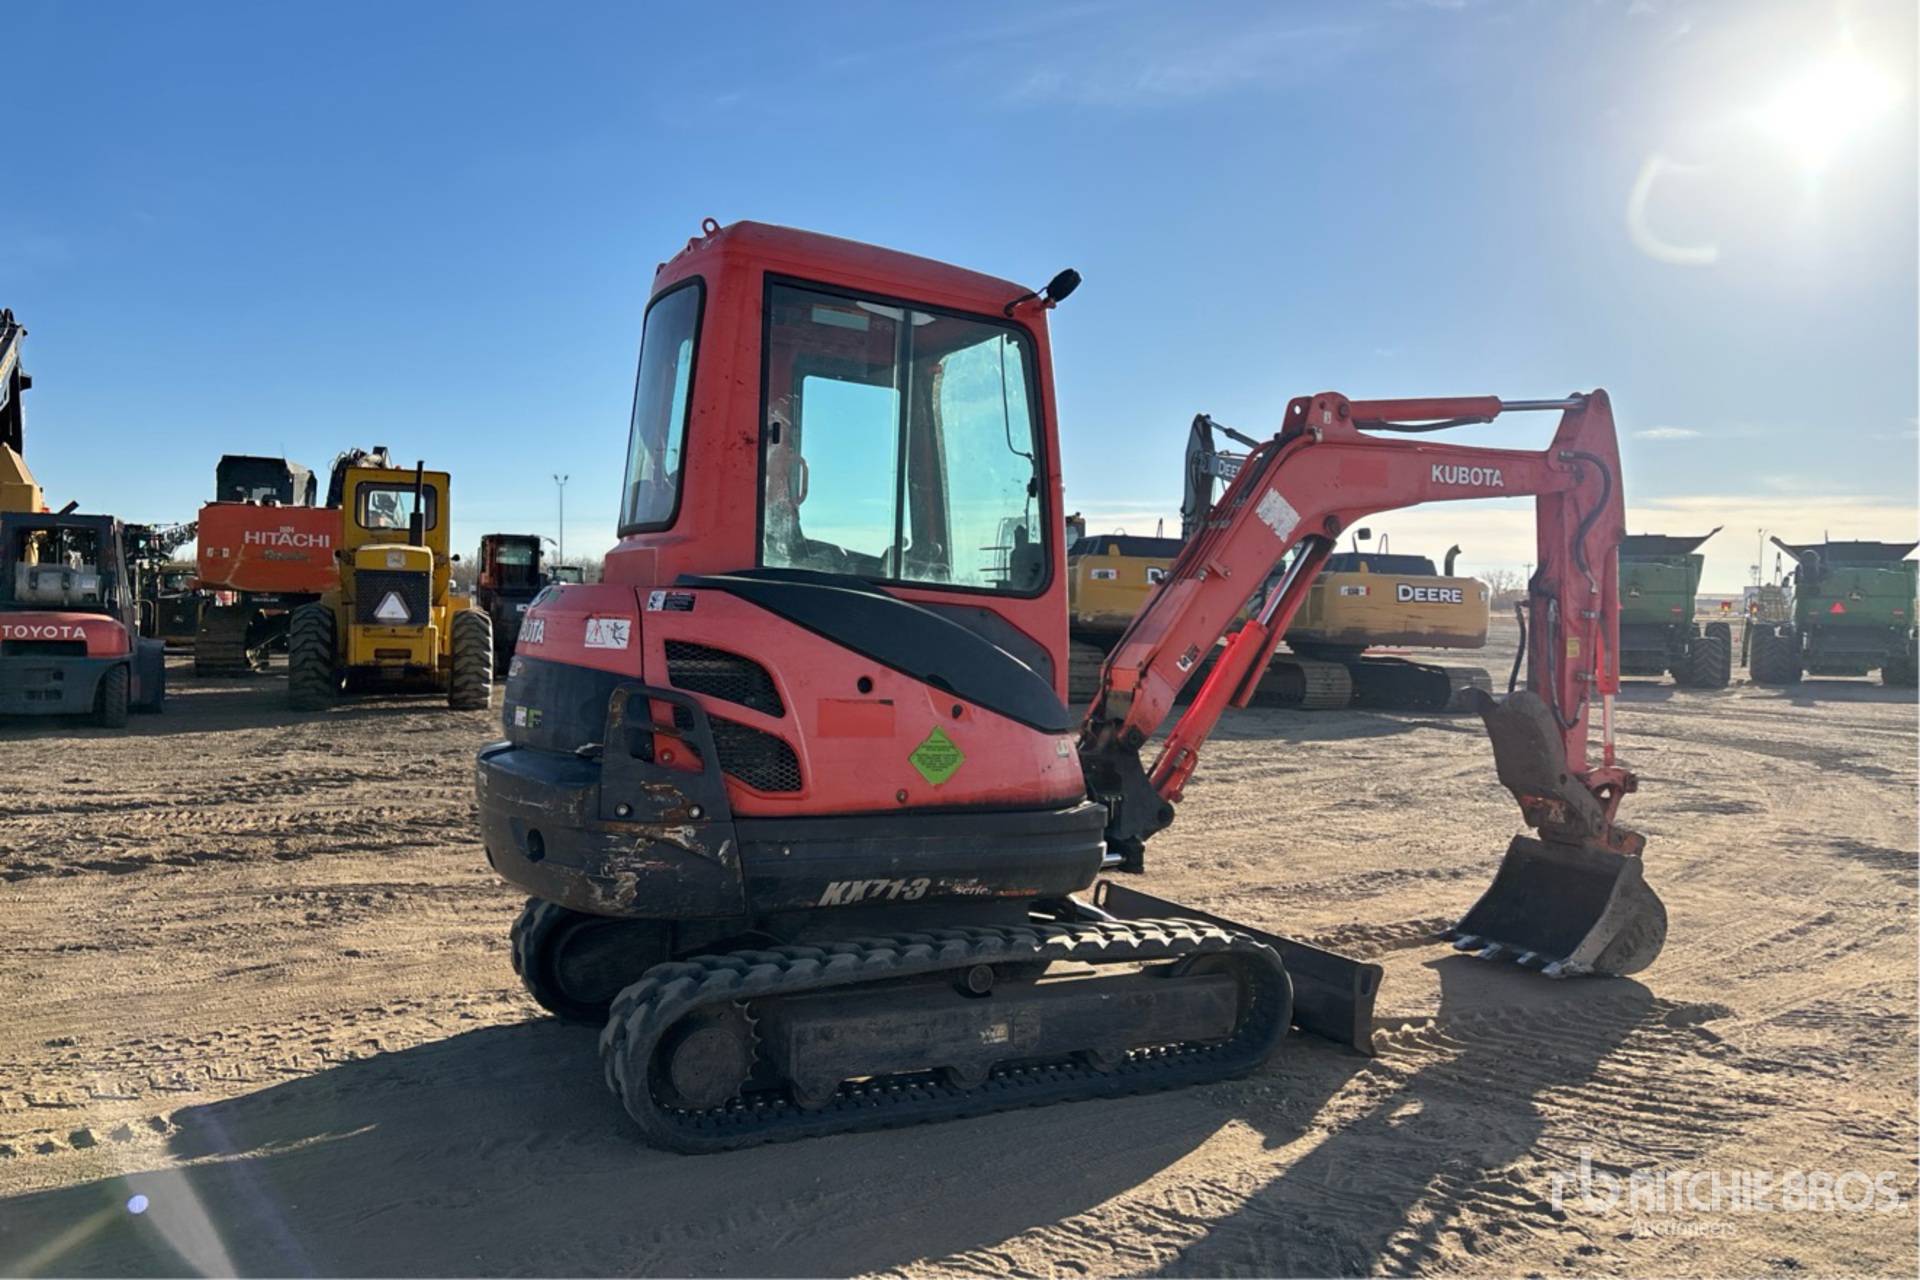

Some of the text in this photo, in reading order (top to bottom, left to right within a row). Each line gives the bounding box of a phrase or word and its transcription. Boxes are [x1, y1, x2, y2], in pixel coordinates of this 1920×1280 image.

[1218, 459, 1242, 478] DEE
[1431, 464, 1504, 487] KUBOTA
[244, 531, 330, 548] HITACHI
[1398, 584, 1462, 604] DEERE
[2, 625, 87, 639] TOYOTA
[818, 877, 931, 906] KX71-3
